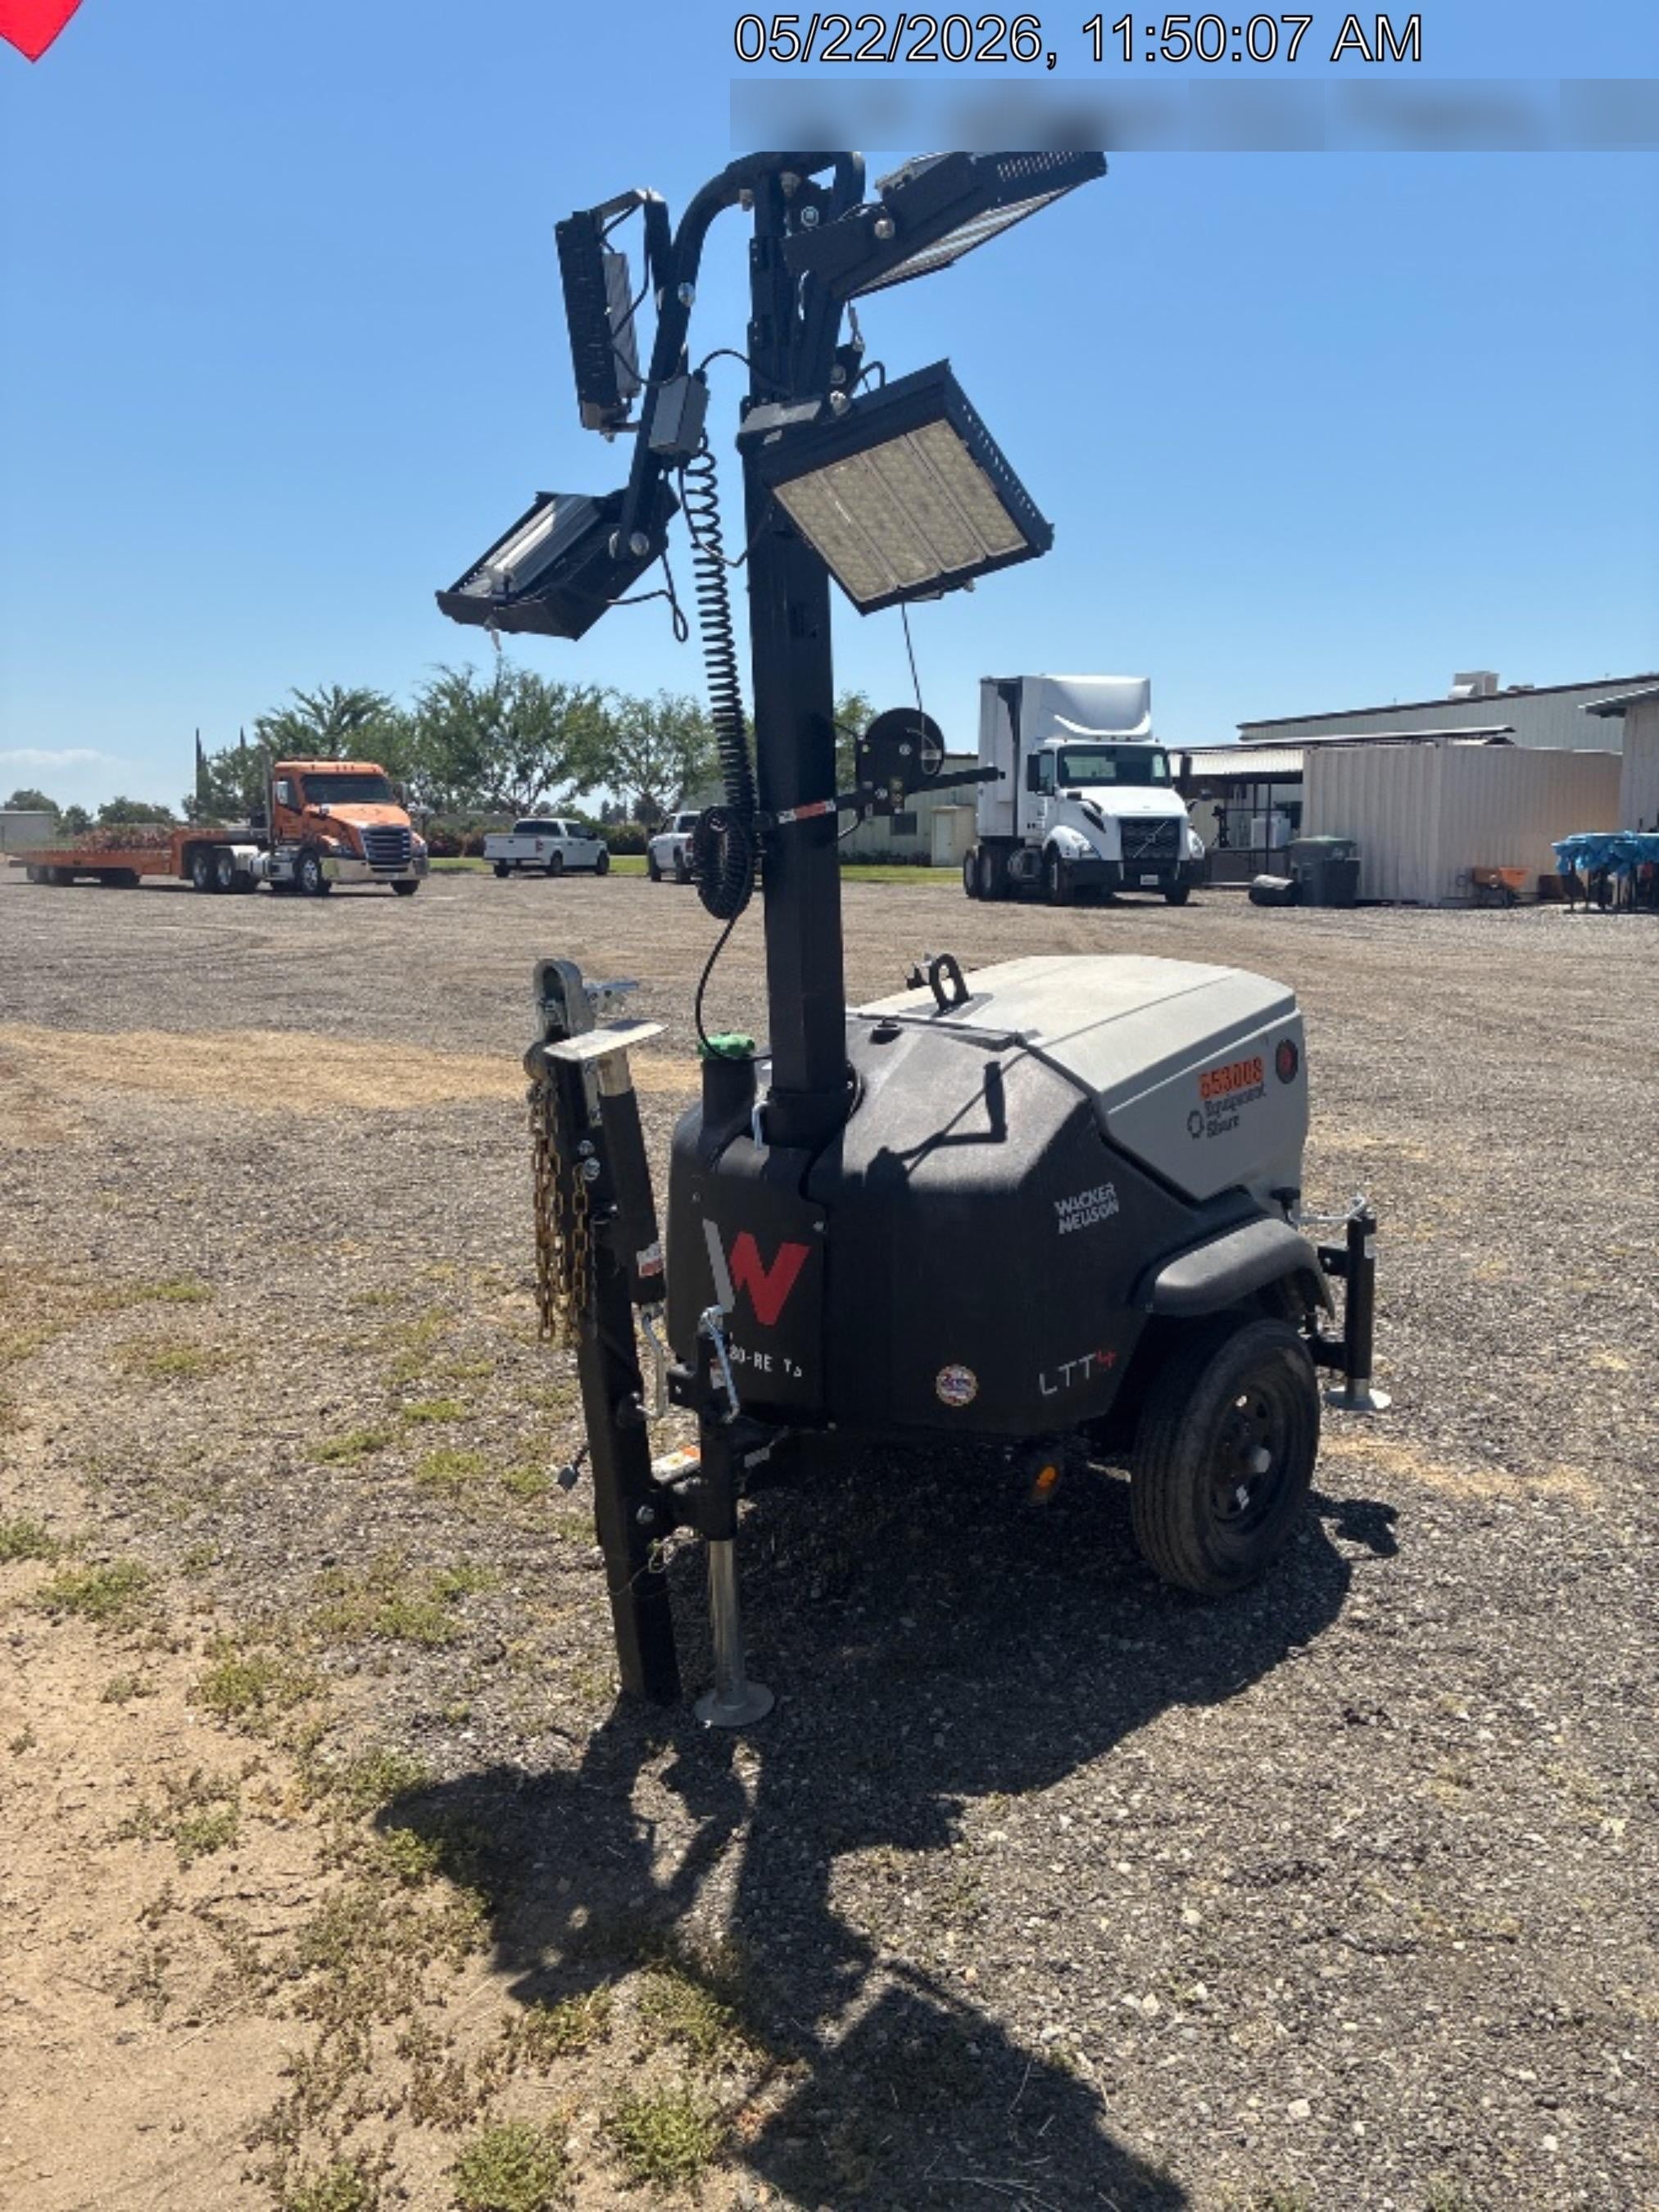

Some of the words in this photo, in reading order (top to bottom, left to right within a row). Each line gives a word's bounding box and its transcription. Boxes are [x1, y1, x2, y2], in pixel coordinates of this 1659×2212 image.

[1199, 1056, 1262, 1099] 653008
[1054, 1181, 1116, 1217] WACKER
[1058, 1198, 1119, 1235] NEUSON
